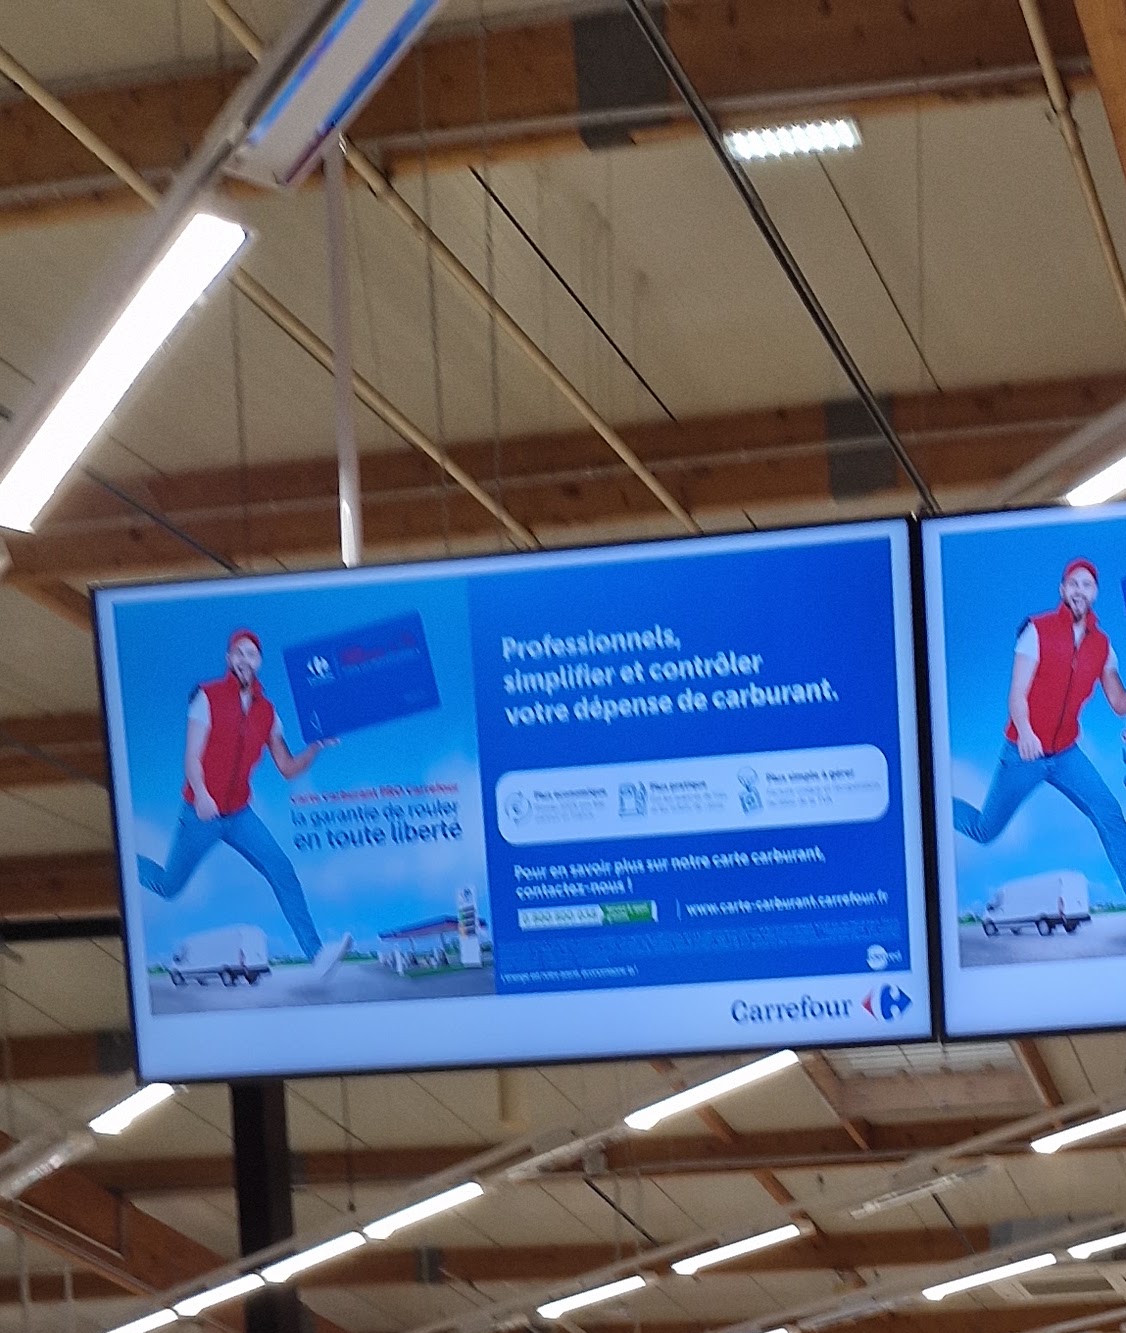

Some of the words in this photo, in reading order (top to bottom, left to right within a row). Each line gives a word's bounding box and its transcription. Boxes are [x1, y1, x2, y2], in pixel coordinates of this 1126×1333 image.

[501, 623, 681, 662] Professionnels,
[503, 663, 616, 697] simplifier
[619, 661, 645, 685] et
[649, 650, 764, 684] contrôler
[505, 701, 570, 727] votre
[573, 695, 674, 726] dépense
[677, 687, 708, 714] de
[712, 677, 839, 709] carburant.
[290, 808, 307, 827] la
[310, 804, 380, 829] garantie
[382, 801, 406, 822] de
[408, 798, 458, 820] rouler
[292, 832, 322, 852] en
[327, 825, 386, 849] toute
[390, 817, 463, 846] liberté
[513, 863, 547, 881] Pour
[549, 864, 567, 880] en
[569, 859, 612, 879] savoir
[614, 857, 645, 878] plus
[646, 857, 668, 874] sur
[671, 854, 710, 871] notre
[712, 850, 750, 868] carte
[751, 845, 827, 866] carburant,
[730, 993, 855, 1025] Carrefour
